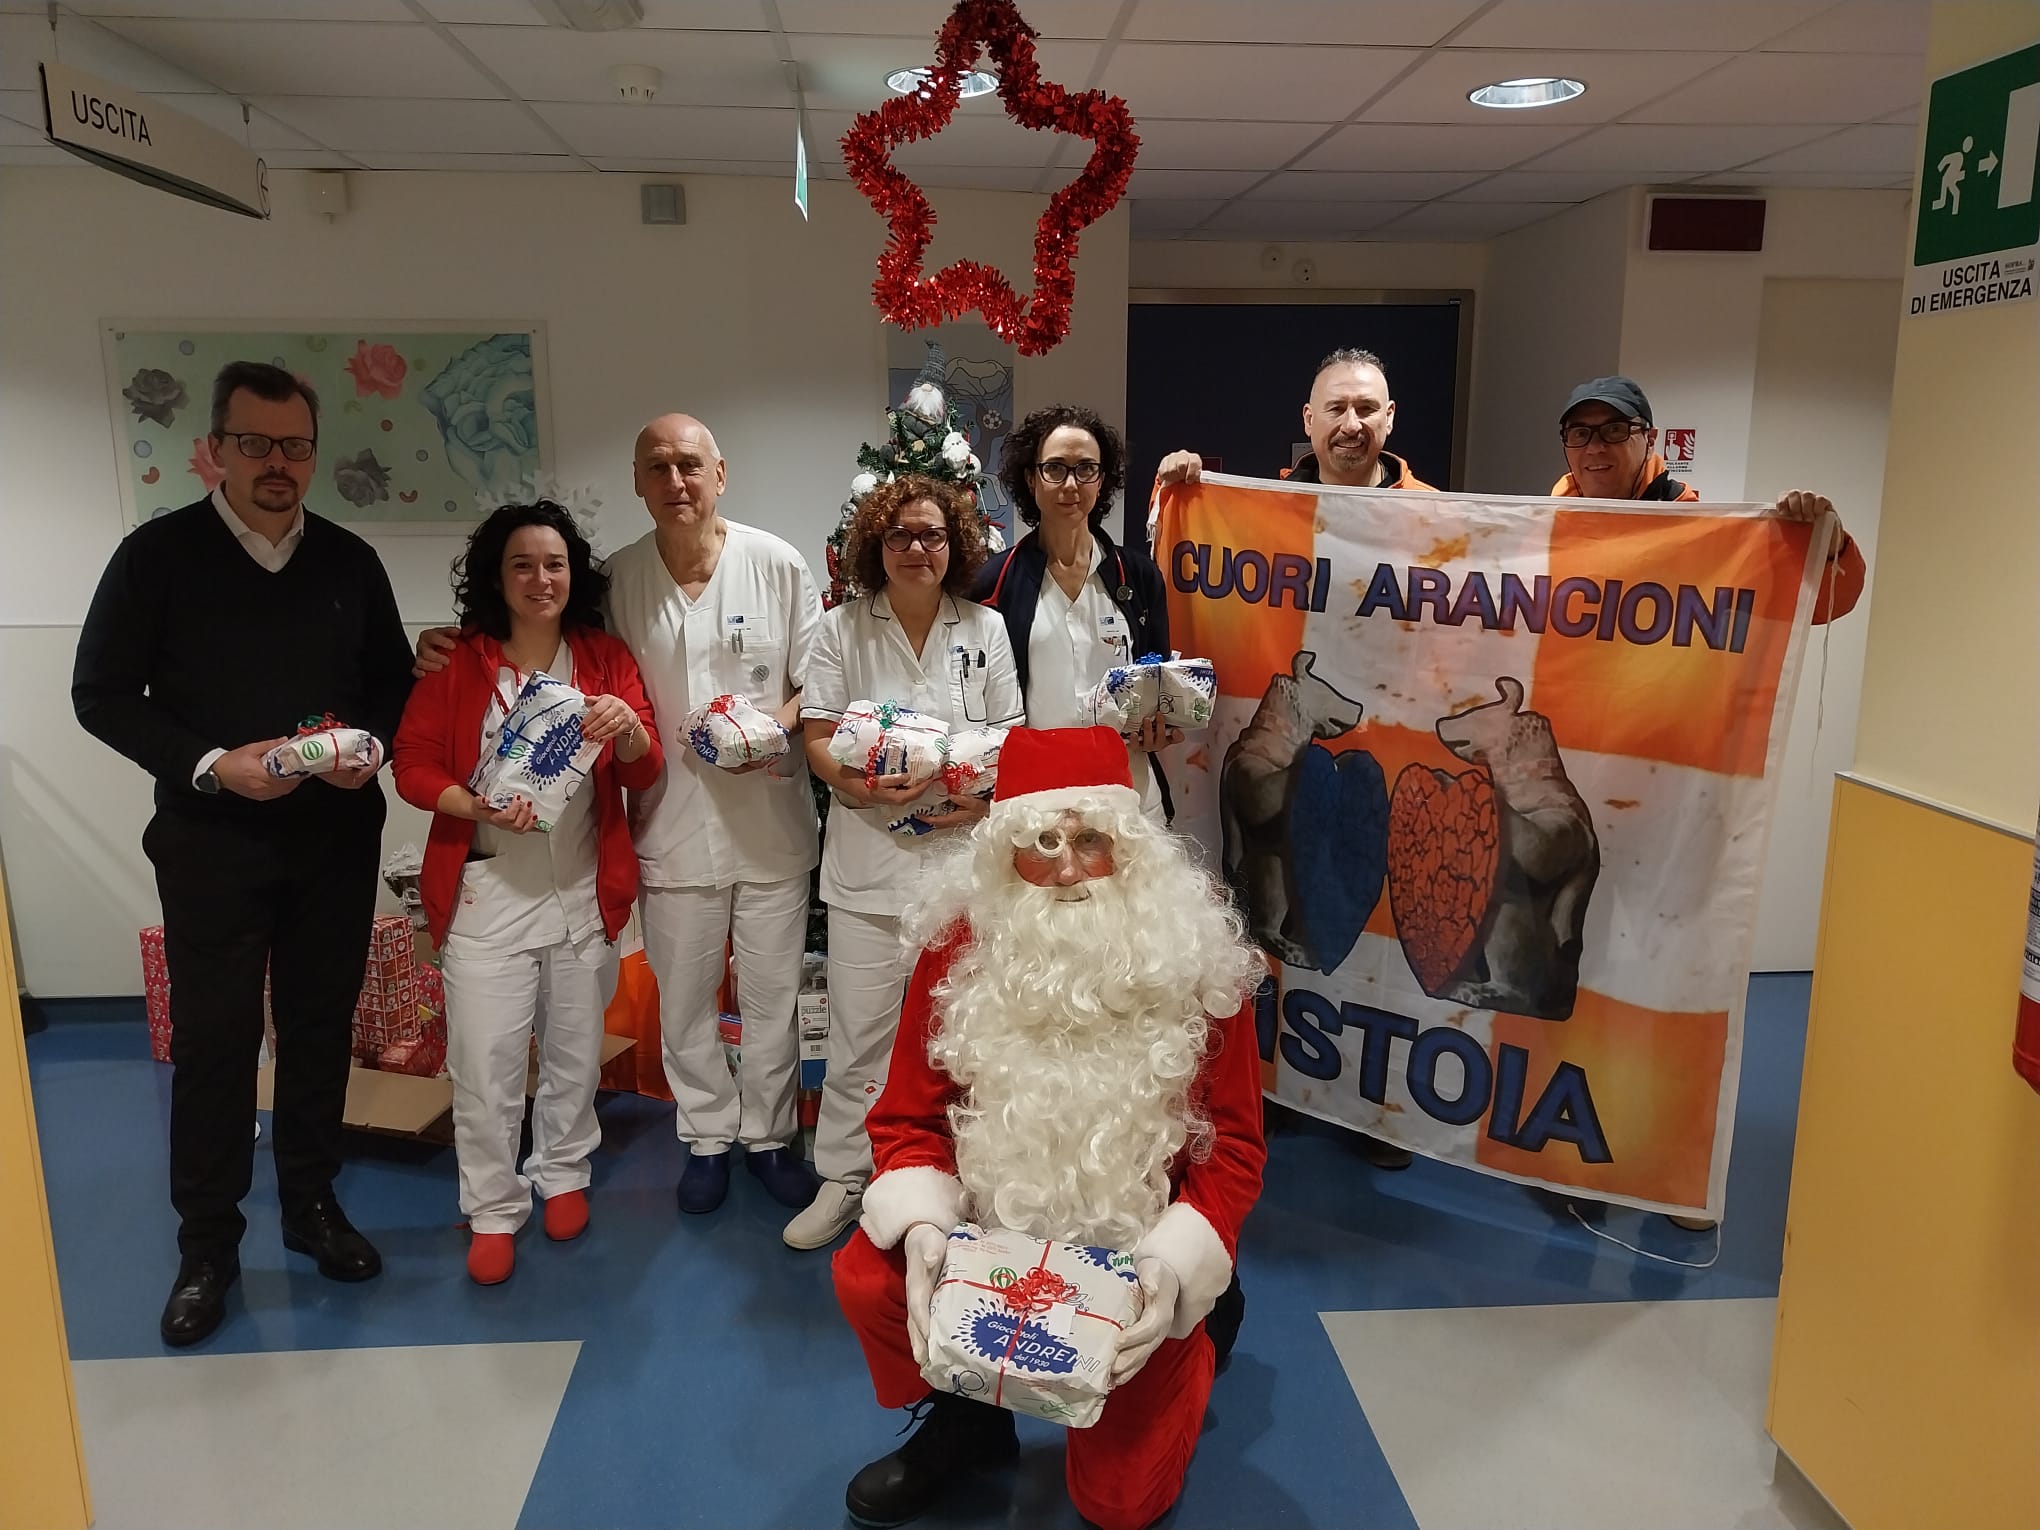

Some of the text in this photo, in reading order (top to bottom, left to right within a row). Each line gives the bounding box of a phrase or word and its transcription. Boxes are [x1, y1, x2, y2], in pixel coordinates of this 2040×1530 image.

[71, 90, 152, 147] USCITA
[1942, 260, 2001, 288] USCITA
[1911, 277, 2032, 315] DI EMERGENZA
[1171, 539, 1755, 654] CUORI ARANCIONI
[800, 1004, 827, 1016] puzzle
[1254, 974, 1614, 1164] ISTOIA
[1013, 1353, 1051, 1368] dal 1930
